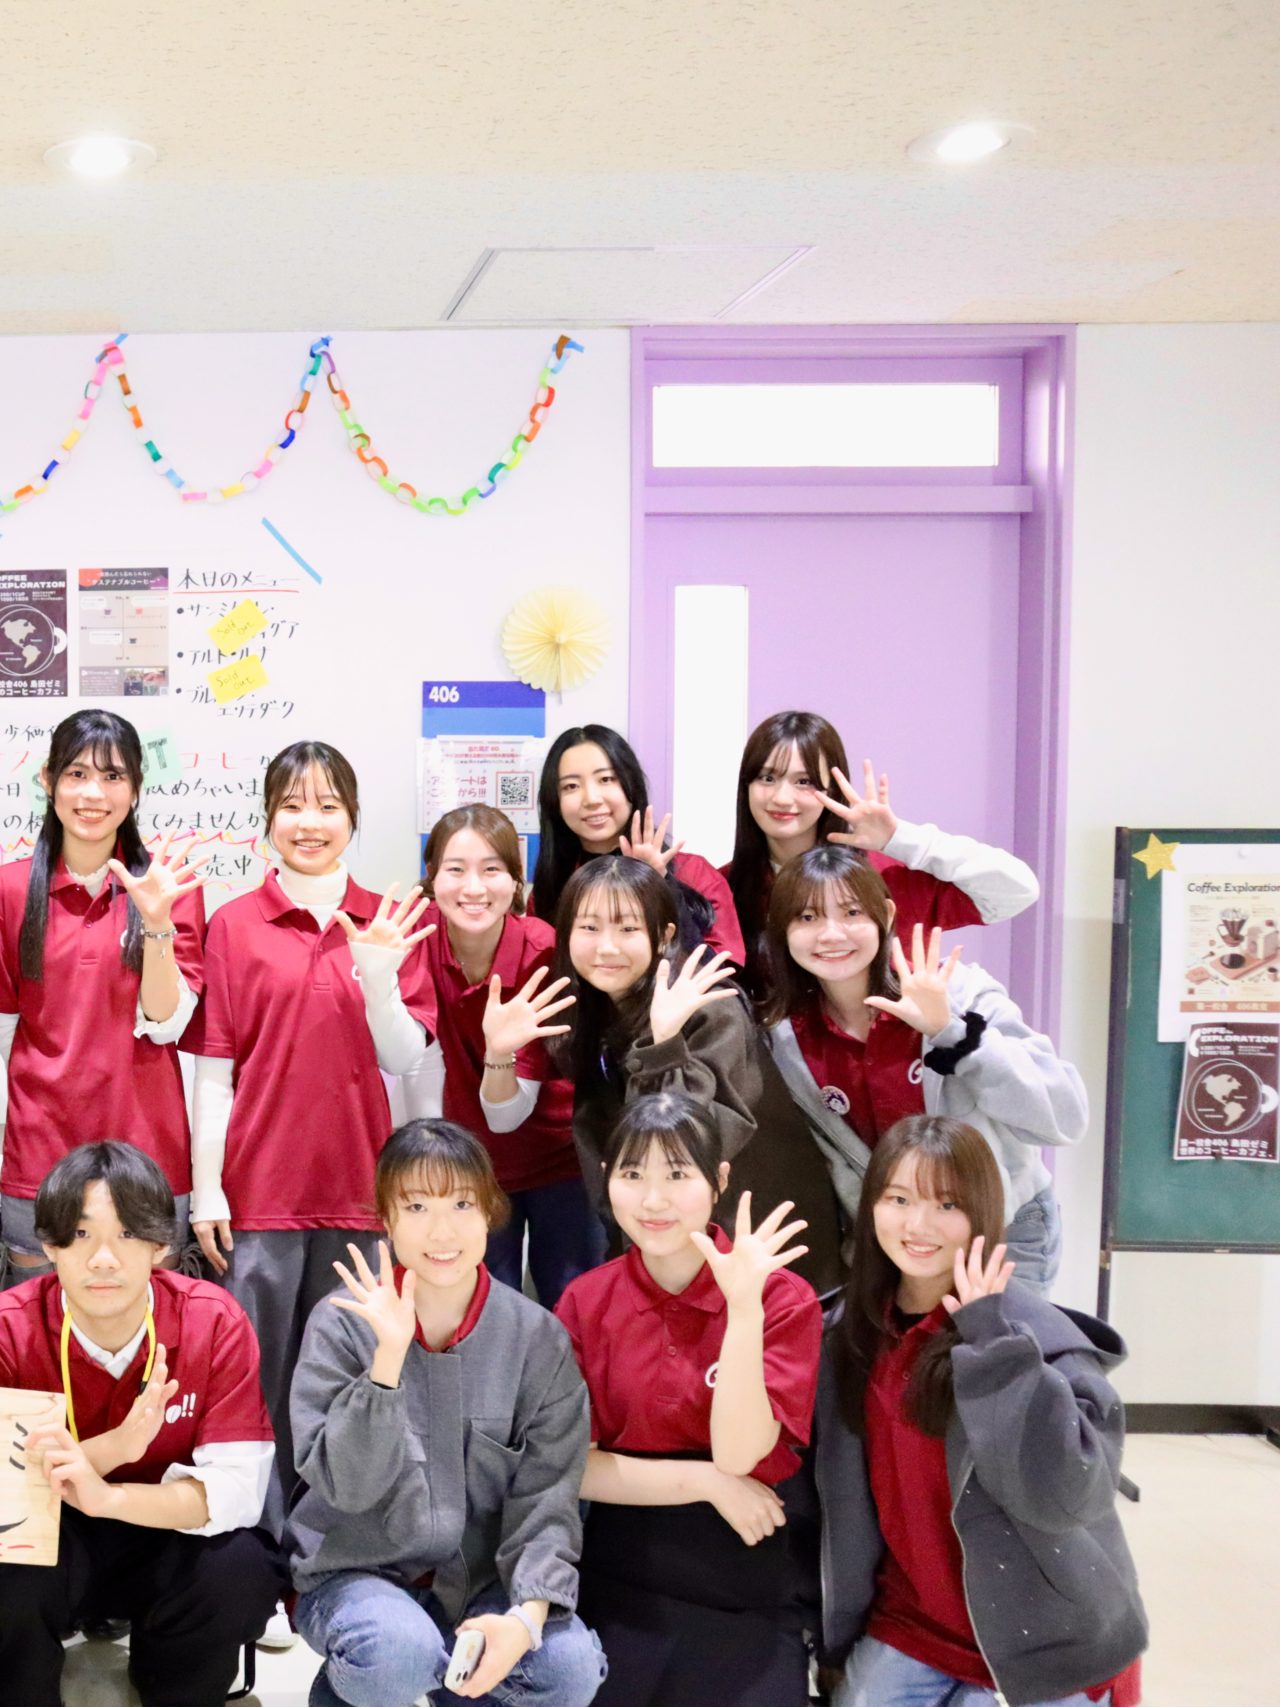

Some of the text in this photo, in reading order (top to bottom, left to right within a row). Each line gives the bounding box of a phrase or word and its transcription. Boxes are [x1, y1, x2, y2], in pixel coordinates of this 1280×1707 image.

[429, 686, 460, 703] 406
[1187, 882, 1221, 894] Coffee
[1200, 1035, 1278, 1044] EXPLORATION
